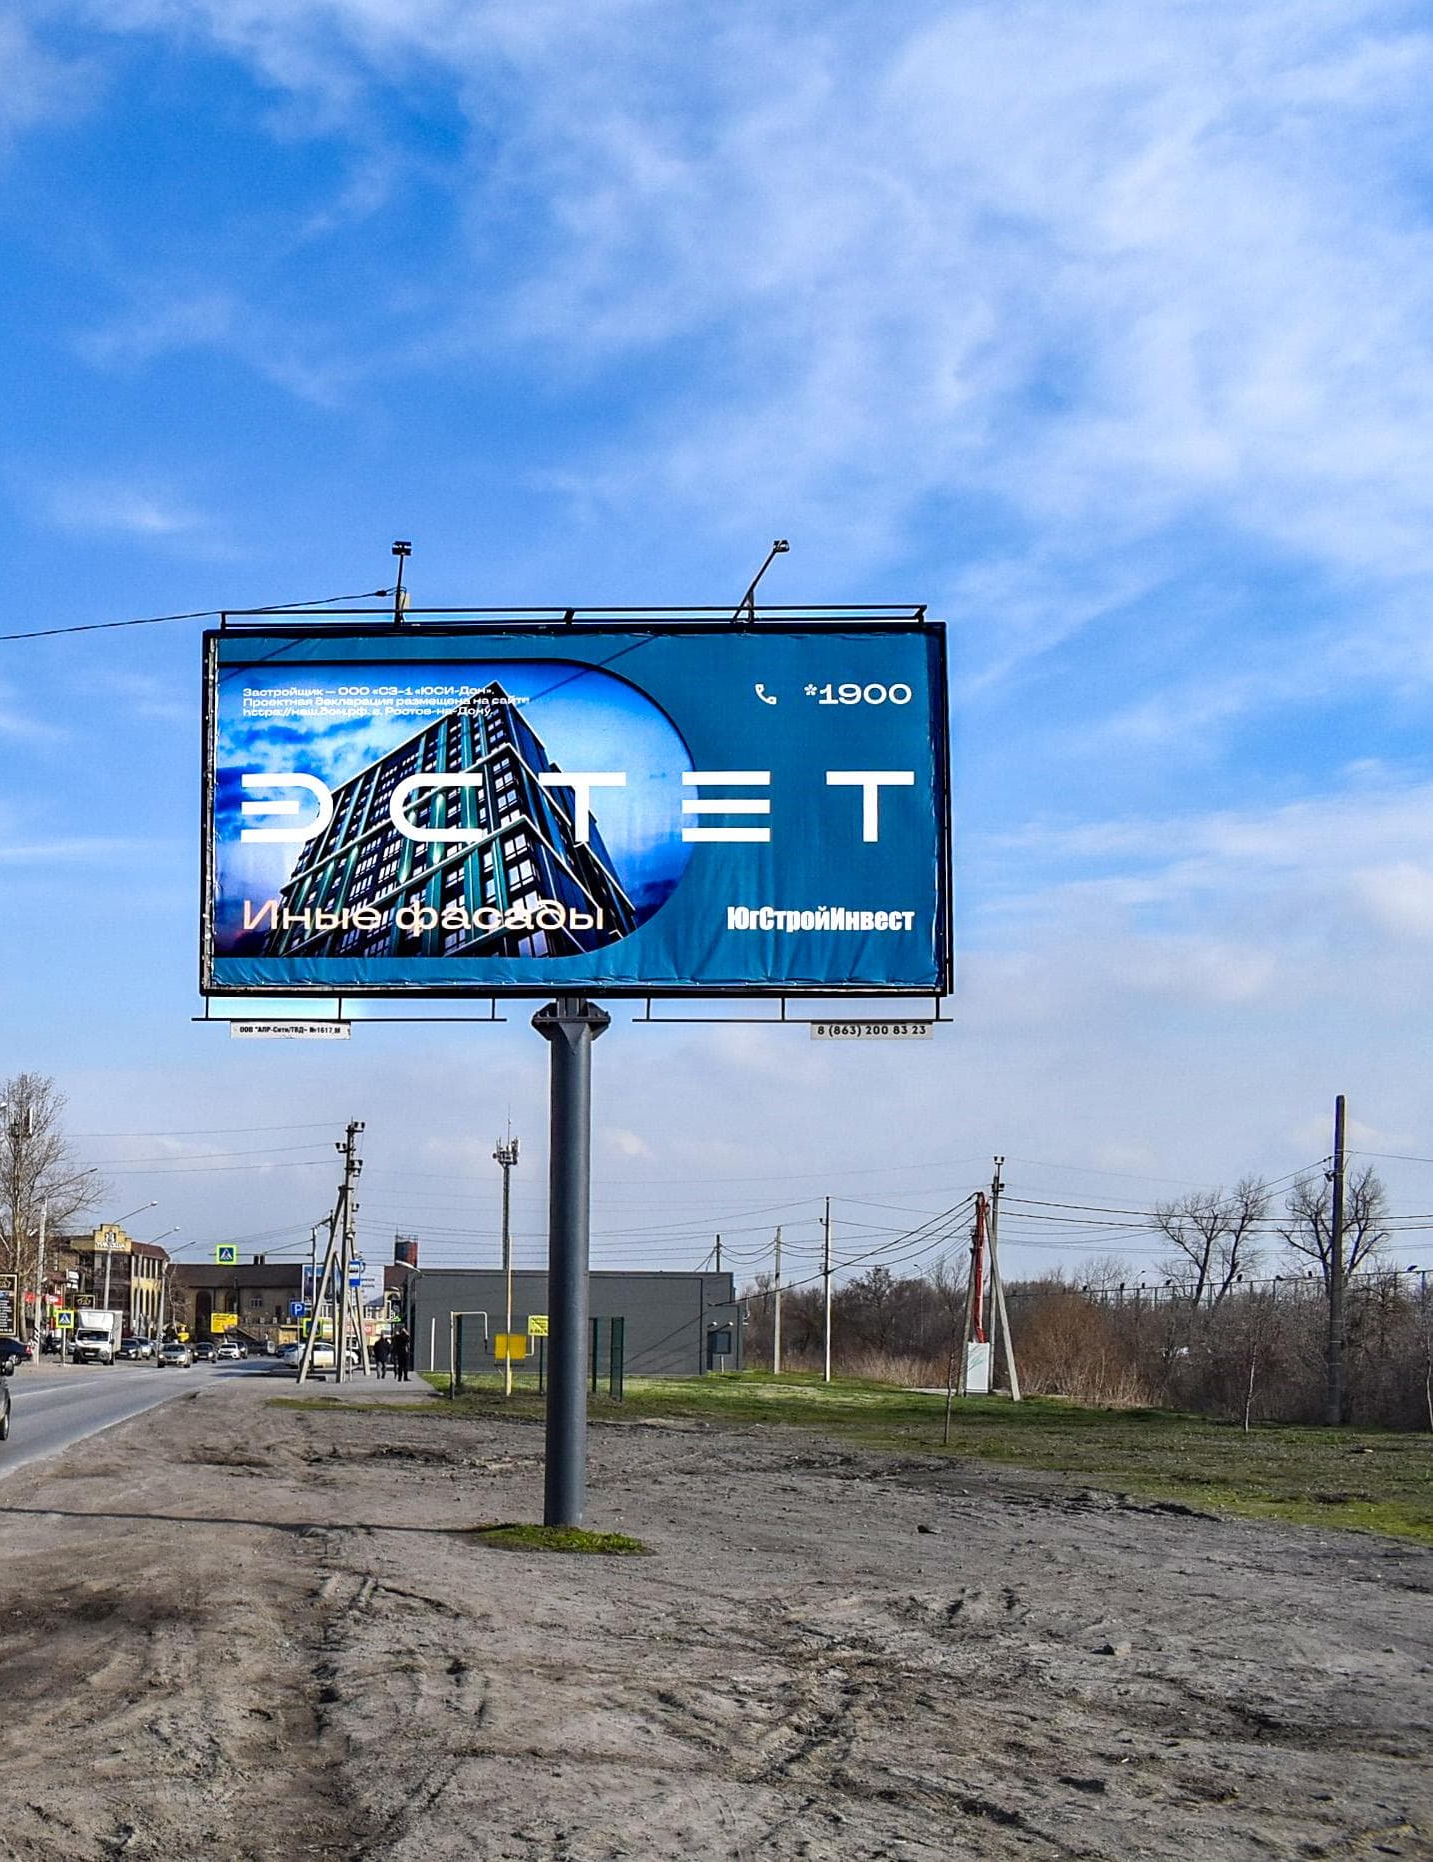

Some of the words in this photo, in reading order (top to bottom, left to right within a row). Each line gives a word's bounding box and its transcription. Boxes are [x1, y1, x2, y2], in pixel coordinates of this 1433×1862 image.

[242, 686, 324, 698] Застройщик
[338, 686, 370, 696] ООО
[243, 698, 313, 707] Проектная
[315, 697, 394, 707] декларация
[396, 698, 471, 707] размещена
[240, 770, 915, 843] ЭСТЕТ
[241, 899, 382, 930] Иные
[395, 898, 604, 938] фасады
[726, 905, 916, 933] ЮгСтройИнвест
[817, 1025, 825, 1035] 8
[828, 1024, 862, 1037] (863)
[865, 1025, 889, 1035] 200
[893, 1025, 908, 1035] 83
[911, 1025, 926, 1035] 23
